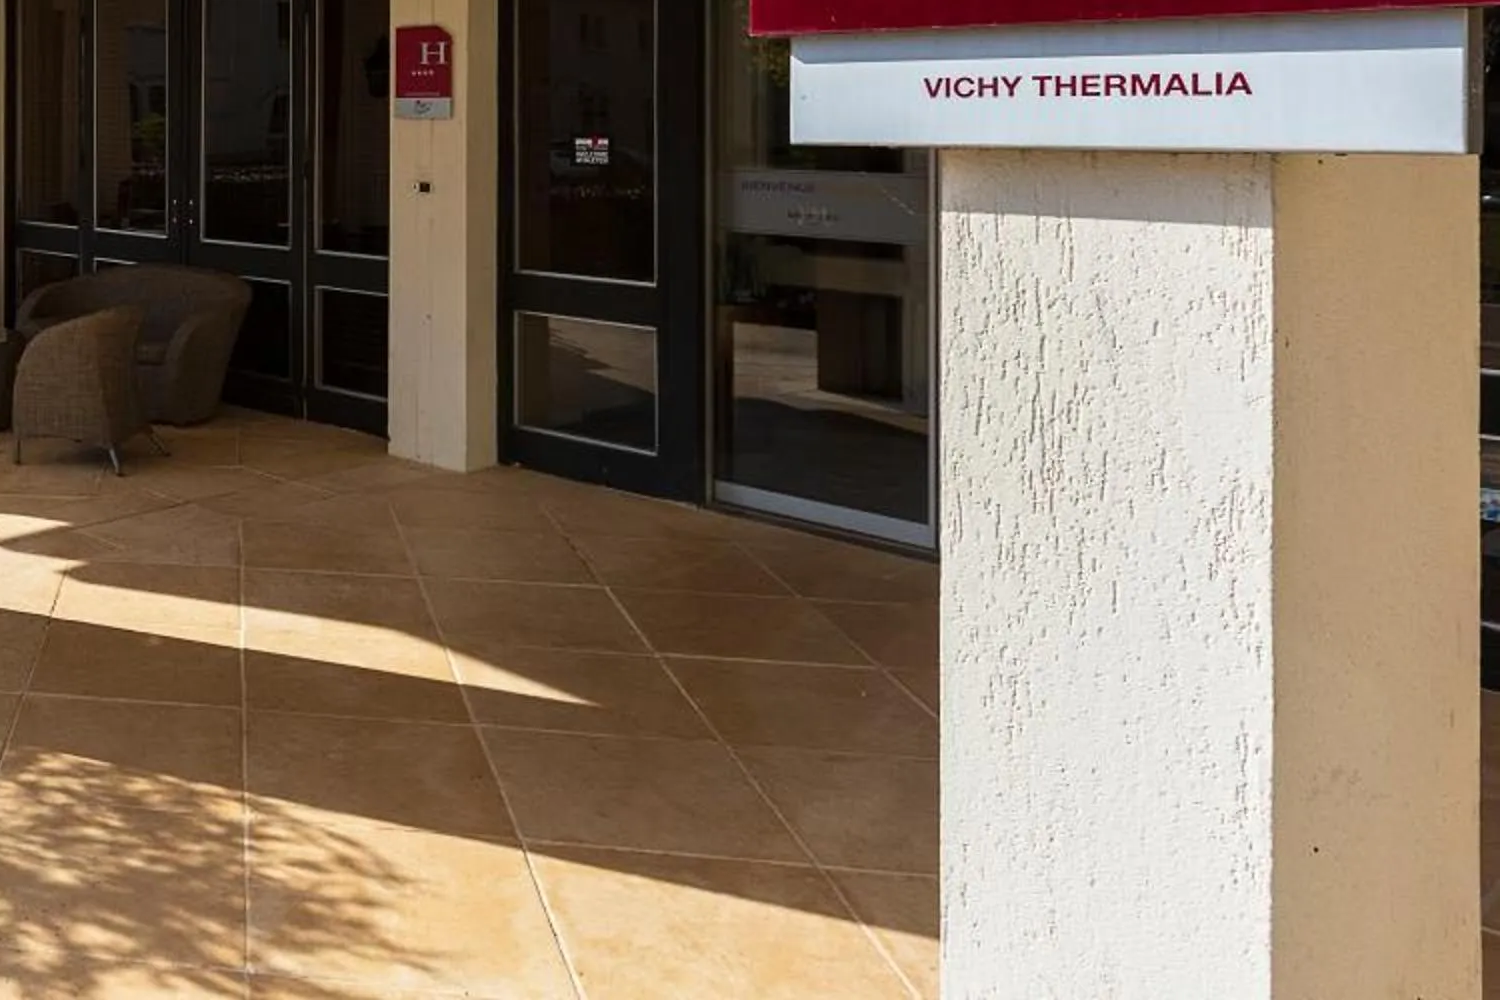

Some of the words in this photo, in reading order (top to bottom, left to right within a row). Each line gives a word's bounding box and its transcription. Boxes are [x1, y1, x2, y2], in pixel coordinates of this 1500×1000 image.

[420, 41, 448, 66] H
[923, 76, 1023, 99] VICHY
[1031, 71, 1253, 98] THERMALIA
